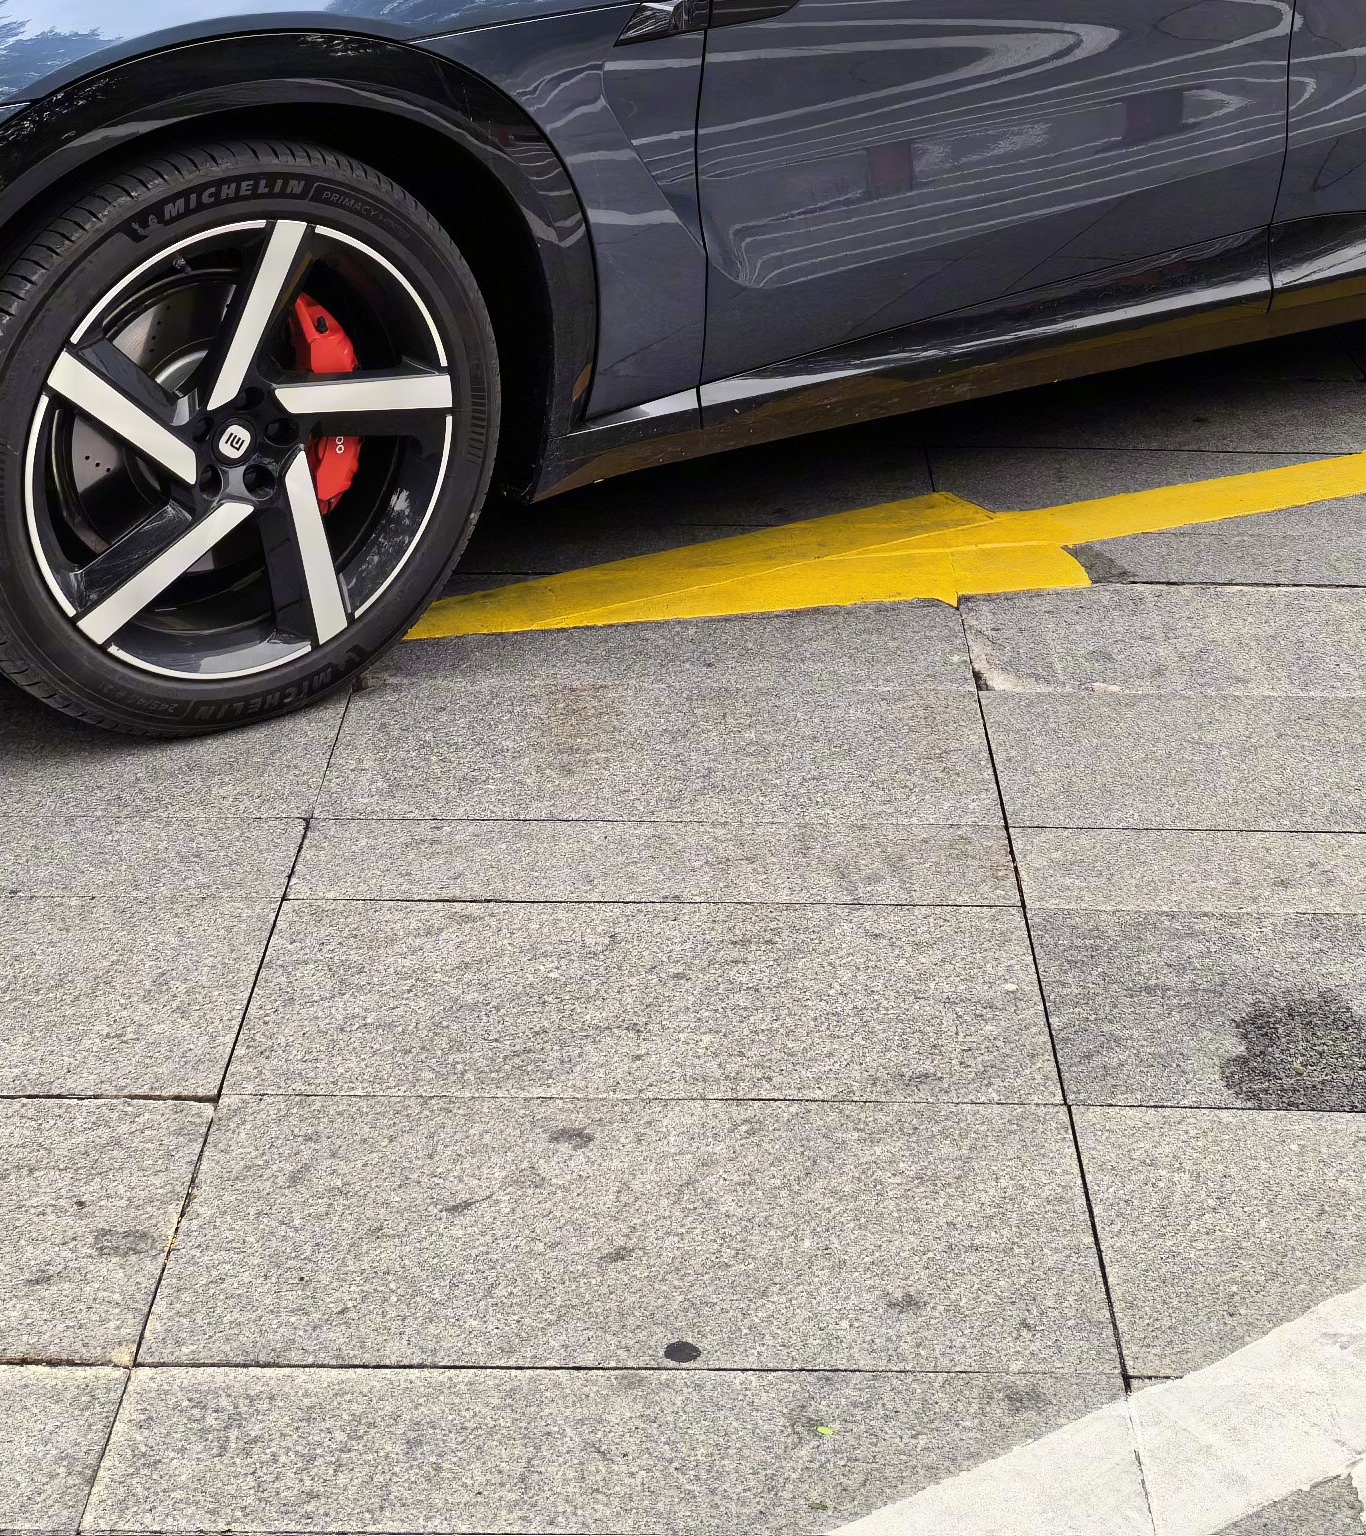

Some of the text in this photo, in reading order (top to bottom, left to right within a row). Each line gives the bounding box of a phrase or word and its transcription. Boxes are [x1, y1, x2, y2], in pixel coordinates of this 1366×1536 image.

[163, 179, 379, 221] MICHELIN PRIMACY
[194, 666, 333, 720] MICHELIN
